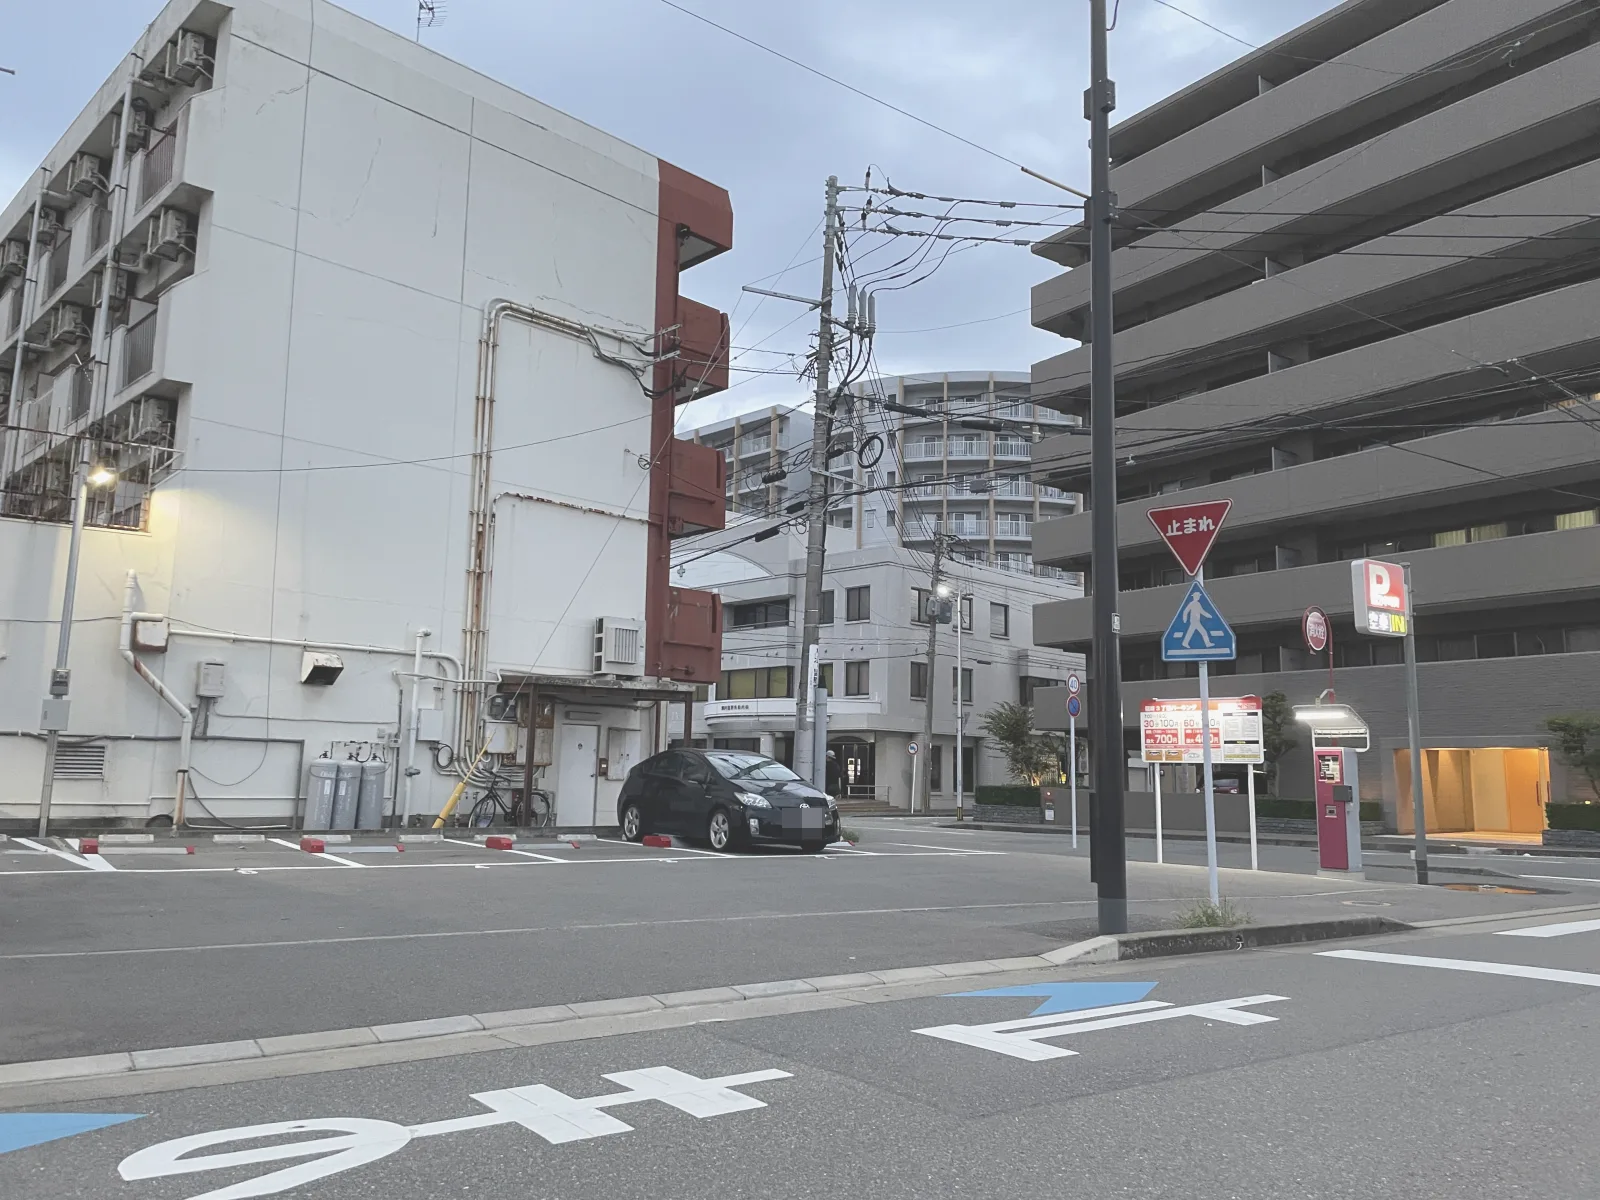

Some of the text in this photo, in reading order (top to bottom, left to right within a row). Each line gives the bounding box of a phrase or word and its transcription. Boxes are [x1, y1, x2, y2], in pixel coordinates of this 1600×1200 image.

[1166, 516, 1216, 537] 止まれ
[1309, 623, 1325, 639] 消火栓
[1392, 614, 1405, 632] IN
[1069, 680, 1077, 690] 40
